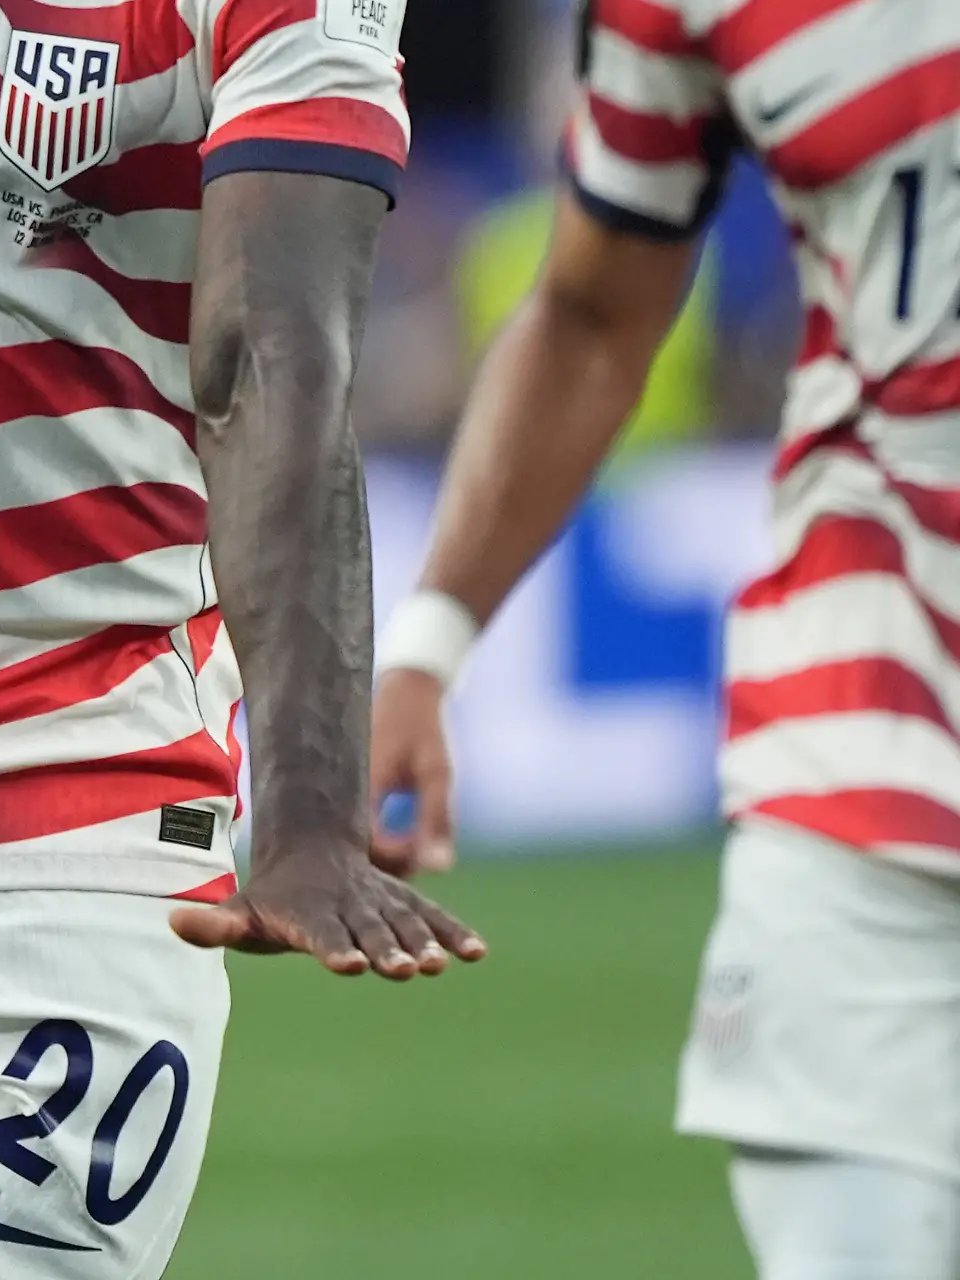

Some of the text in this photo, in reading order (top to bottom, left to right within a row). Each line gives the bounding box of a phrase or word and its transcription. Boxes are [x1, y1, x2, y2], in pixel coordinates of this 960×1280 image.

[13, 39, 110, 102] USA
[2, 190, 25, 209] USA
[28, 200, 45, 218] VS.
[6, 208, 29, 226] LOS
[86, 212, 104, 225] CA
[13, 230, 26, 246] 12
